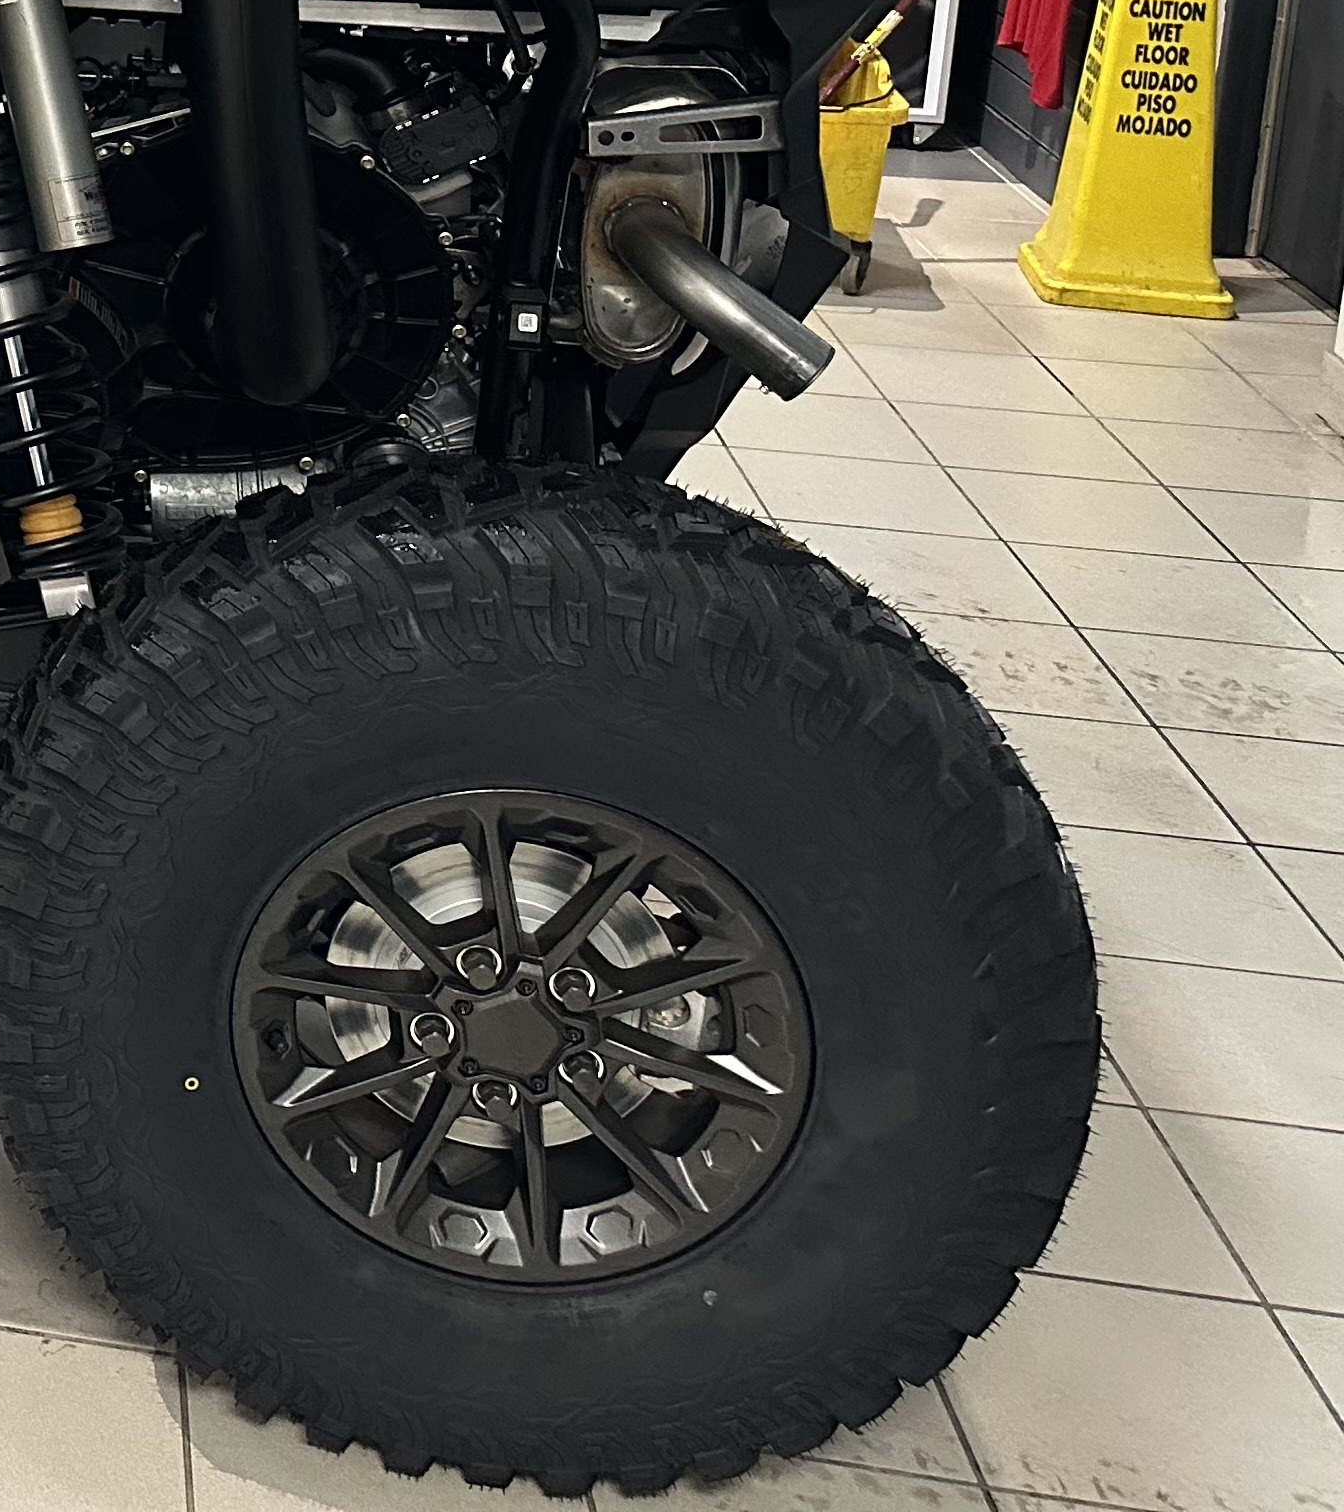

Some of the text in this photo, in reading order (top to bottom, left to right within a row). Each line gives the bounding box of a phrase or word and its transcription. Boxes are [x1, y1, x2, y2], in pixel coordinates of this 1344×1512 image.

[1147, 22, 1183, 43] WET
[1135, 44, 1190, 66] FLOOR
[1121, 70, 1198, 94] CUIDADO
[1136, 93, 1177, 115] PISO
[1116, 114, 1192, 138] MOJADO
